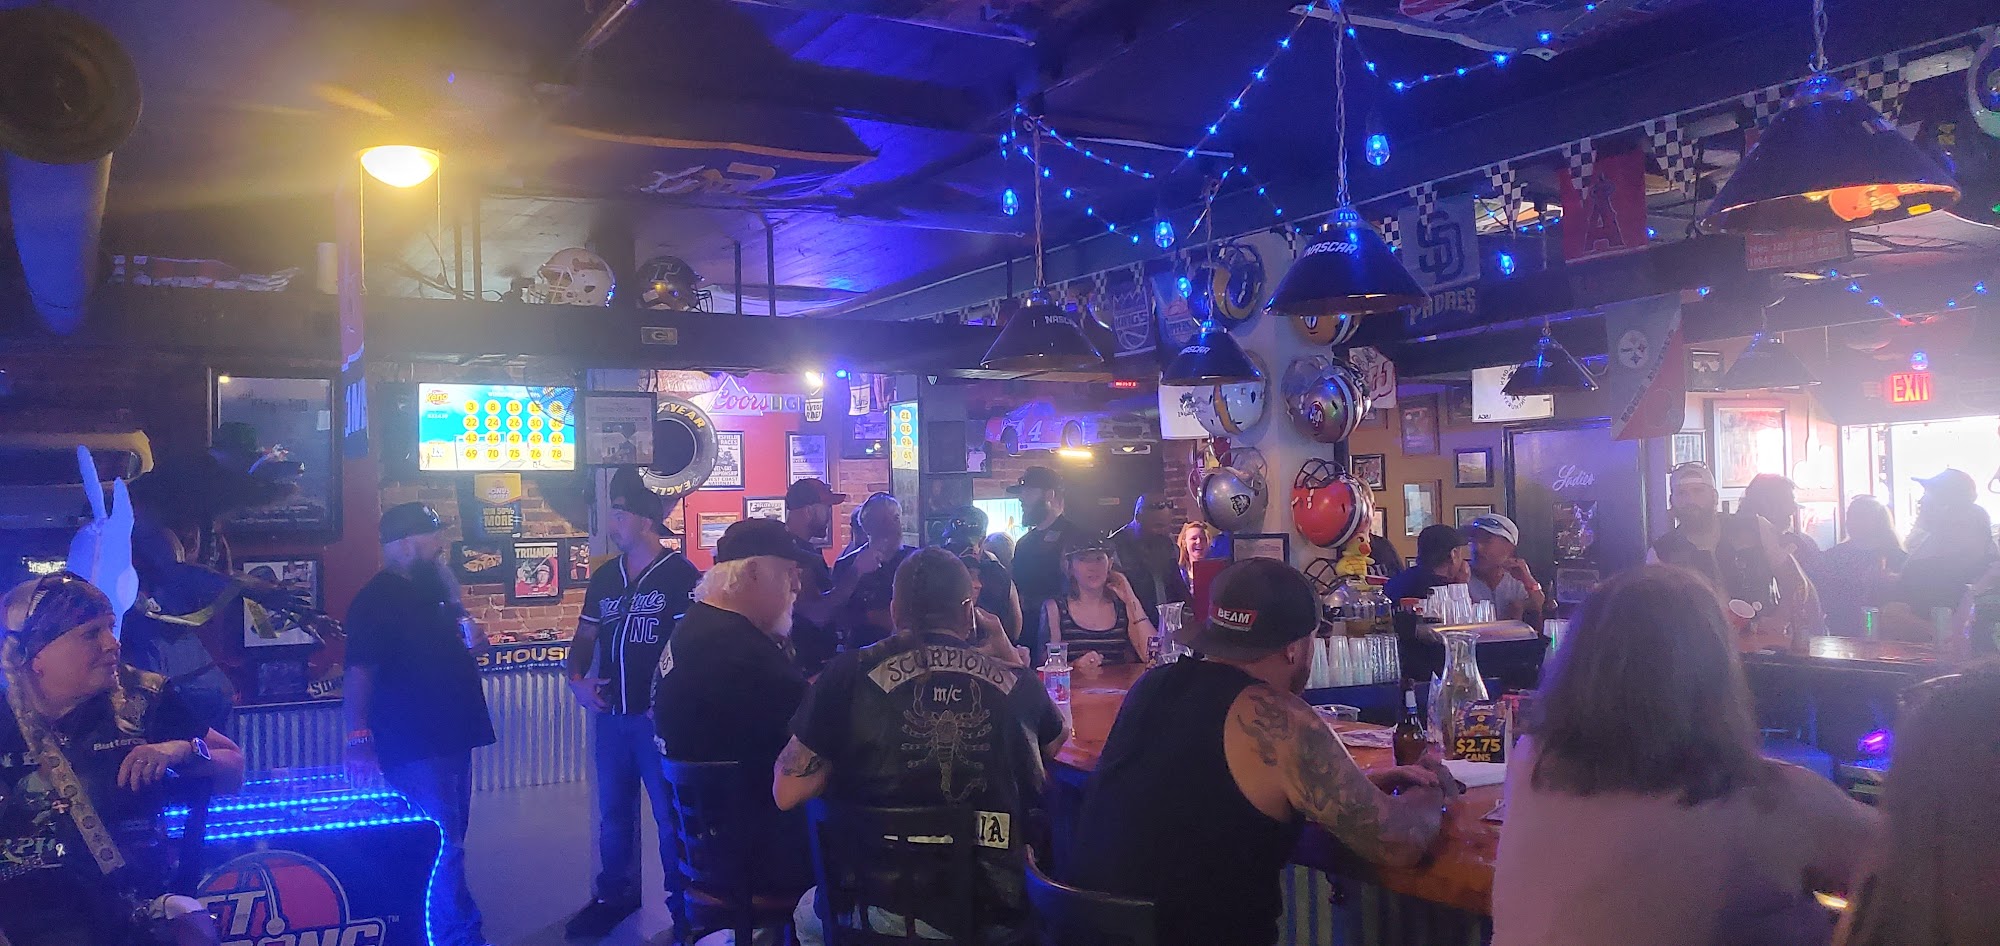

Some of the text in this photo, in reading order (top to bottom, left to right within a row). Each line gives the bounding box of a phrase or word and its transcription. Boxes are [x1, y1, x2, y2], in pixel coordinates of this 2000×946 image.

[1303, 241, 1357, 257] NASCAR
[1893, 374, 1929, 402] EXIT
[509, 403, 520, 412] 13
[713, 388, 768, 411] Coors
[466, 418, 477, 427] 22
[487, 418, 499, 427] 24
[509, 418, 520, 427] 26
[530, 418, 542, 427] 30
[466, 434, 563, 443] 43 44 47 49 66
[466, 449, 562, 458] 69 70 75 76 78
[1552, 465, 1595, 491] Ladies
[651, 480, 692, 496] EAGLE
[484, 515, 514, 527] MORE
[1217, 608, 1250, 624] BEAM
[630, 617, 660, 644] NC
[1456, 738, 1501, 754] $2.75
[1465, 753, 1491, 761] CANS
